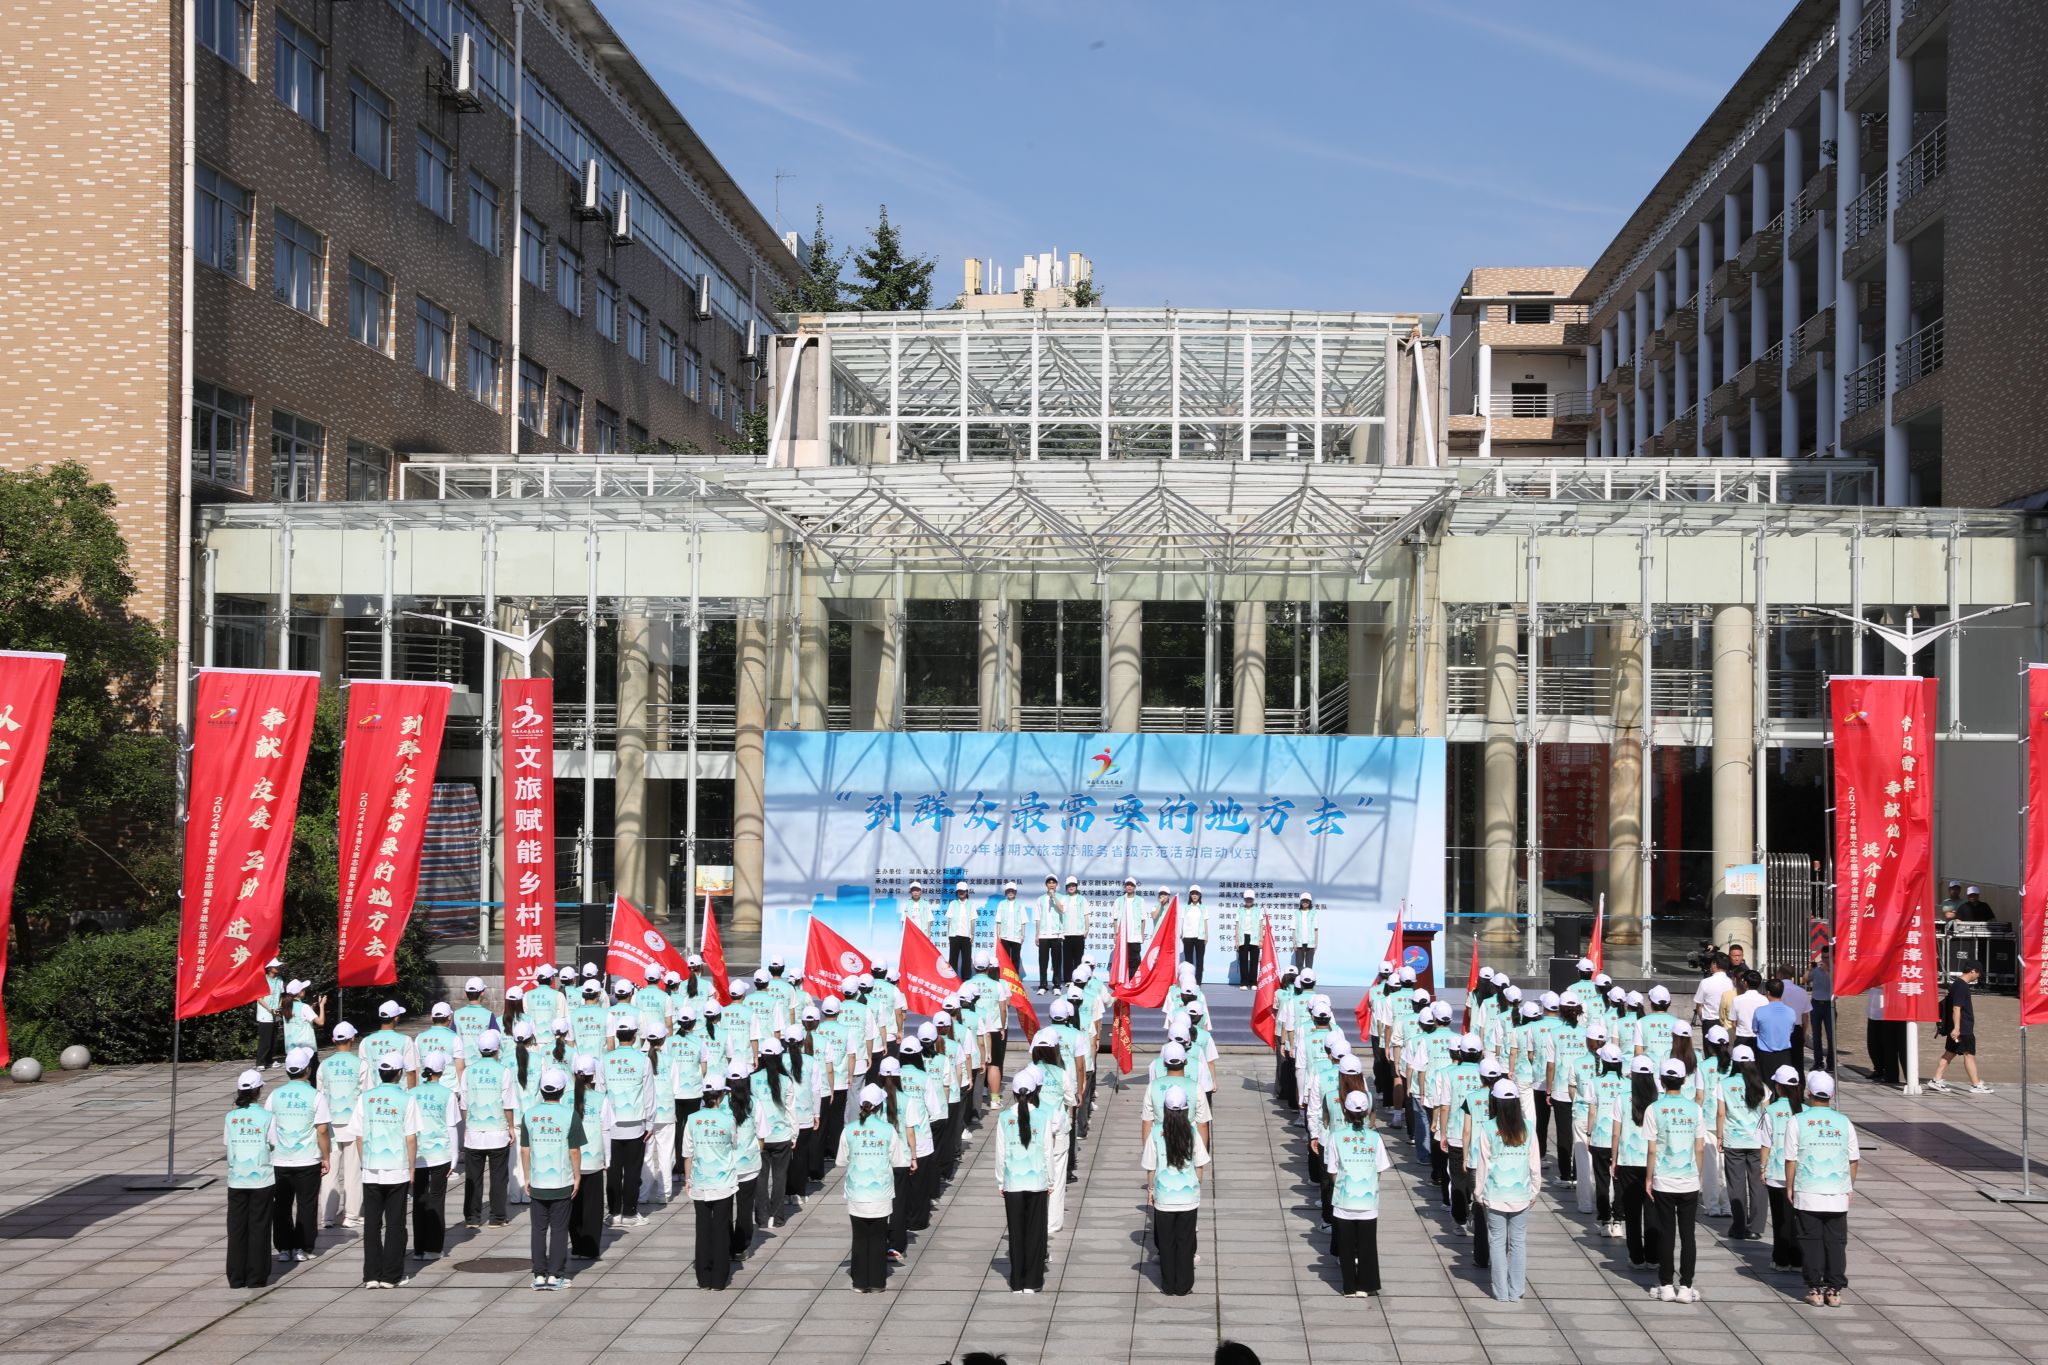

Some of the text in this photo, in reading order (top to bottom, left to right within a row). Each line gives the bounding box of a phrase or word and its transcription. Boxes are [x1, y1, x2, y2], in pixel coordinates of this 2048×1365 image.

[248, 776, 278, 830] 友爱
[364, 714, 424, 957] 到群众最需要的地方去
